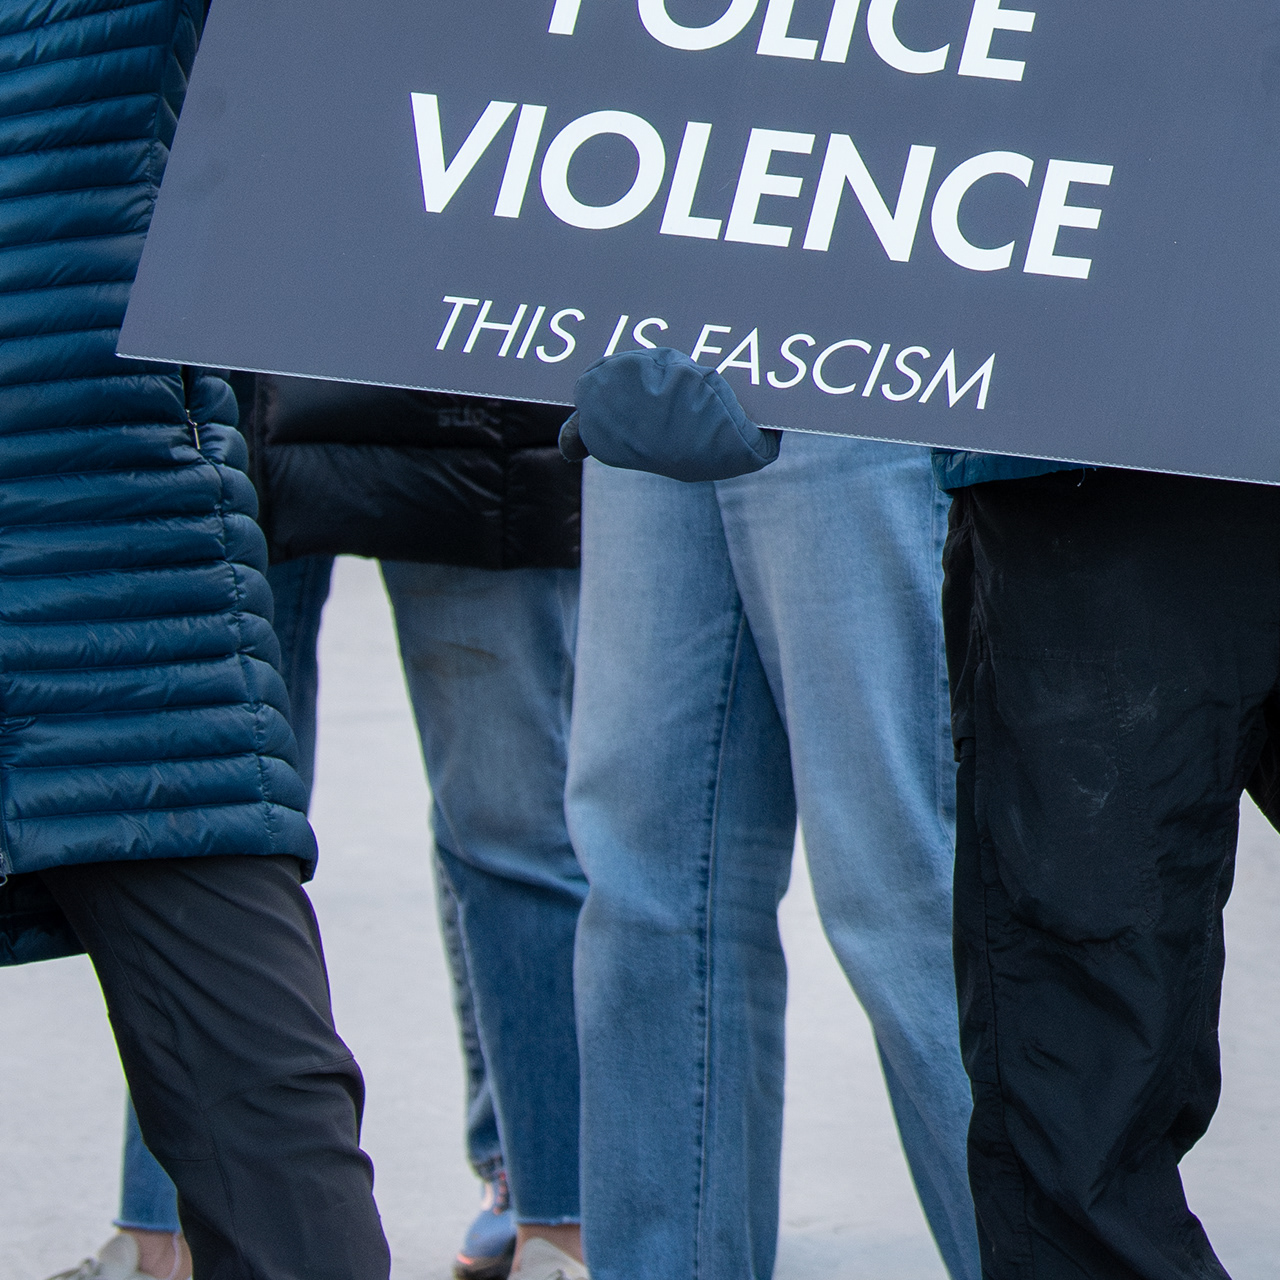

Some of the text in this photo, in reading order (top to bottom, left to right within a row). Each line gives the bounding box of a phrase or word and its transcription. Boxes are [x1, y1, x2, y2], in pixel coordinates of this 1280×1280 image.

[411, 93, 1114, 279] VIOLENCE
[435, 295, 996, 410] THIS IS FASCISM
